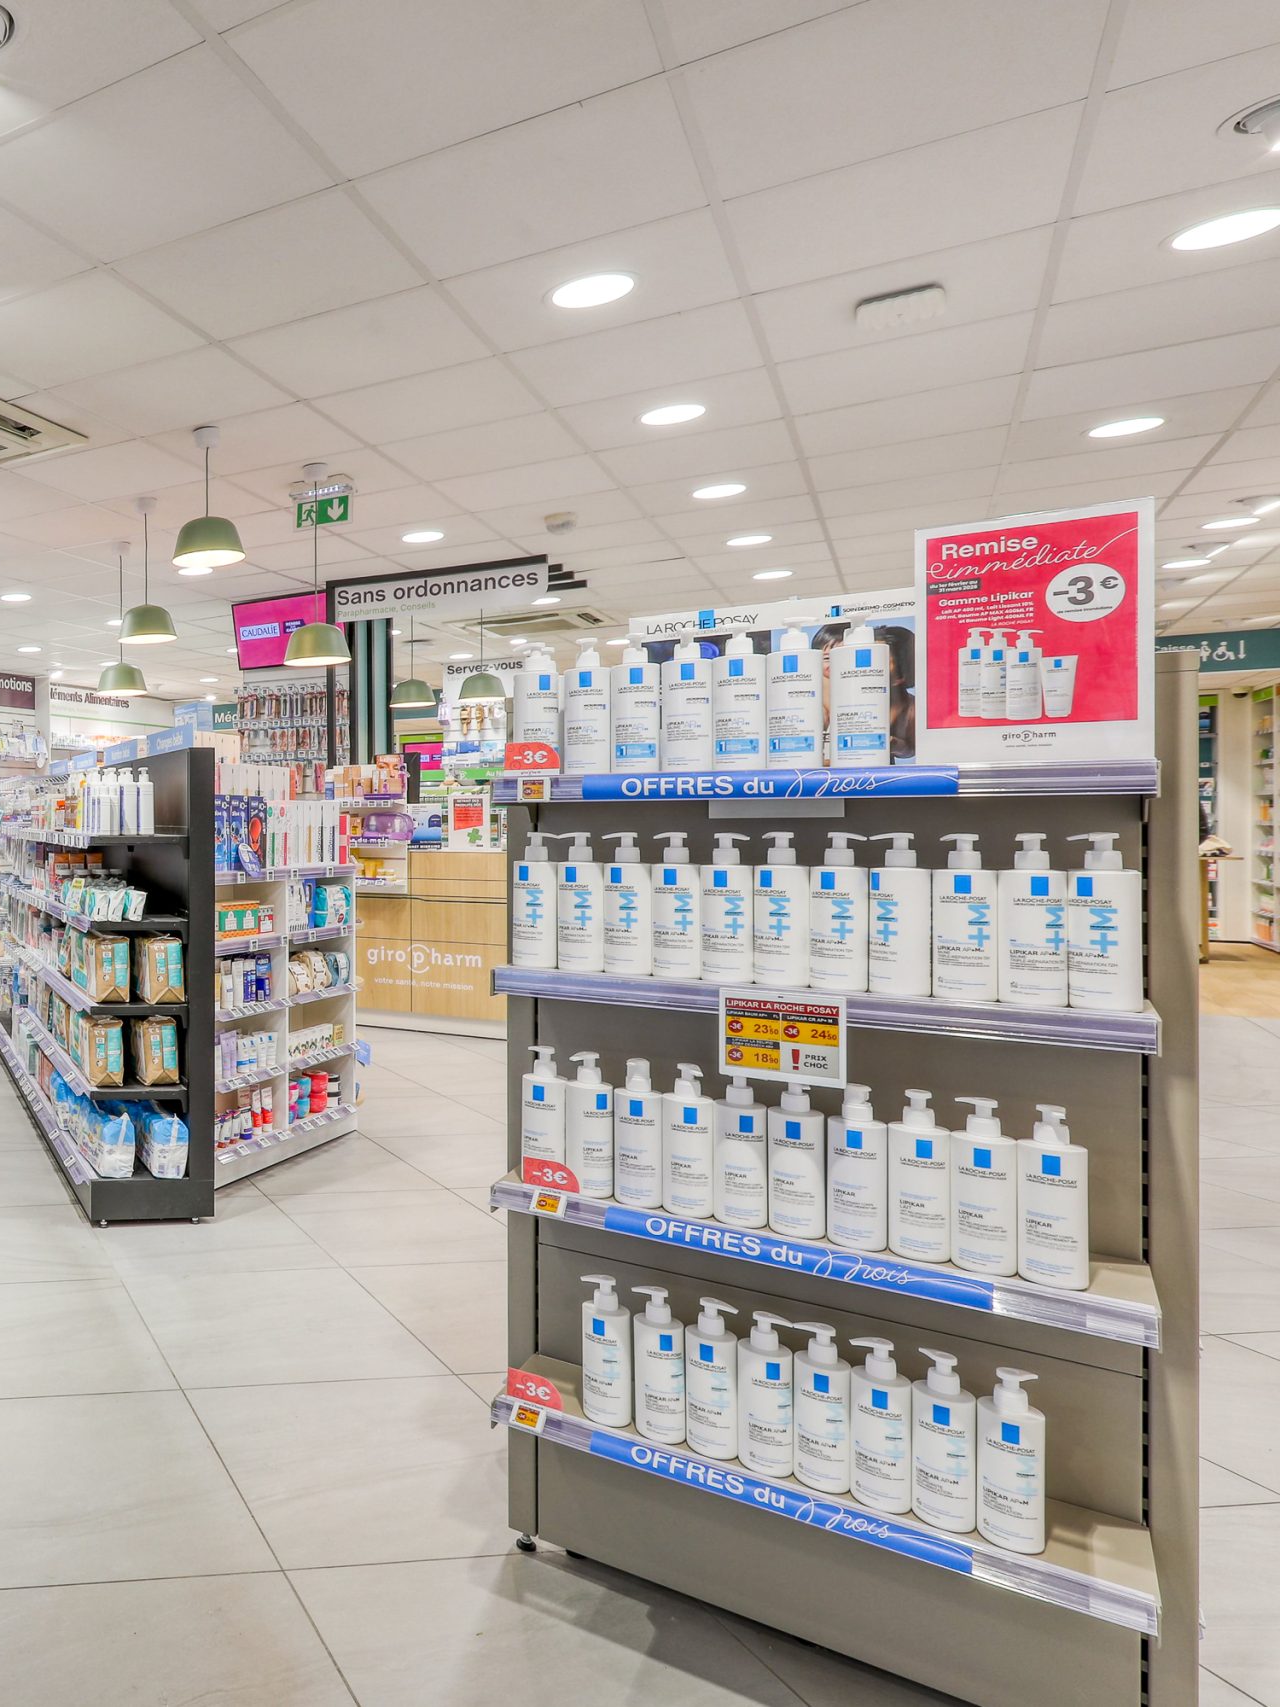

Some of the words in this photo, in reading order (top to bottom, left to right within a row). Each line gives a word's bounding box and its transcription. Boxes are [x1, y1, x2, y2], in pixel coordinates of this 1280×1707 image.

[941, 535, 1039, 561] Remise
[930, 539, 1110, 581] immédiate
[337, 586, 386, 606] Sans
[393, 569, 539, 601] ordonnances
[939, 596, 989, 607] Gamme
[991, 591, 1034, 603] Lipikar
[337, 604, 397, 619] Parapharmacie,
[400, 601, 436, 613] Conseils
[241, 625, 278, 638] CAUDALIE
[646, 624, 665, 635] LA
[665, 618, 711, 633] ROCHE
[714, 613, 759, 629] POSAY
[446, 659, 523, 676] Servez-vous
[84, 692, 130, 709] Alimentaires
[1001, 729, 1057, 742] giropharm
[513, 750, 549, 764] -3€
[621, 776, 733, 798] OFFRES
[742, 777, 775, 795] du
[367, 944, 482, 971] giropharm
[374, 976, 394, 985] votre
[420, 979, 441, 989] notre
[442, 982, 474, 991] mission
[726, 999, 760, 1009] LIPIKAR
[760, 1001, 772, 1010] LA
[773, 1002, 805, 1012] ROCHE
[807, 1005, 838, 1015] POSAY
[803, 1061, 829, 1070] CHOC
[804, 1054, 827, 1062] PRIX
[532, 1167, 568, 1186] -3€
[724, 1171, 747, 1179] LIPIKAR
[773, 1177, 795, 1186] LIPIKAR
[833, 1188, 856, 1197] LIPIKAR
[899, 1200, 925, 1209] LIPIKAR
[958, 1209, 984, 1220] LIPIKAR
[1025, 1218, 1053, 1229] LIPIKAR
[644, 1217, 762, 1257] OFFRES
[770, 1245, 804, 1266] du
[515, 1383, 552, 1400] -3€
[748, 1421, 772, 1432] LIPIKAR
[854, 1450, 878, 1465] LIPIKAR
[631, 1445, 745, 1496] OFFRES
[753, 1486, 786, 1510] du
[916, 1467, 939, 1481] LIPIKAR
[982, 1485, 1009, 1502] LIPIKAR
